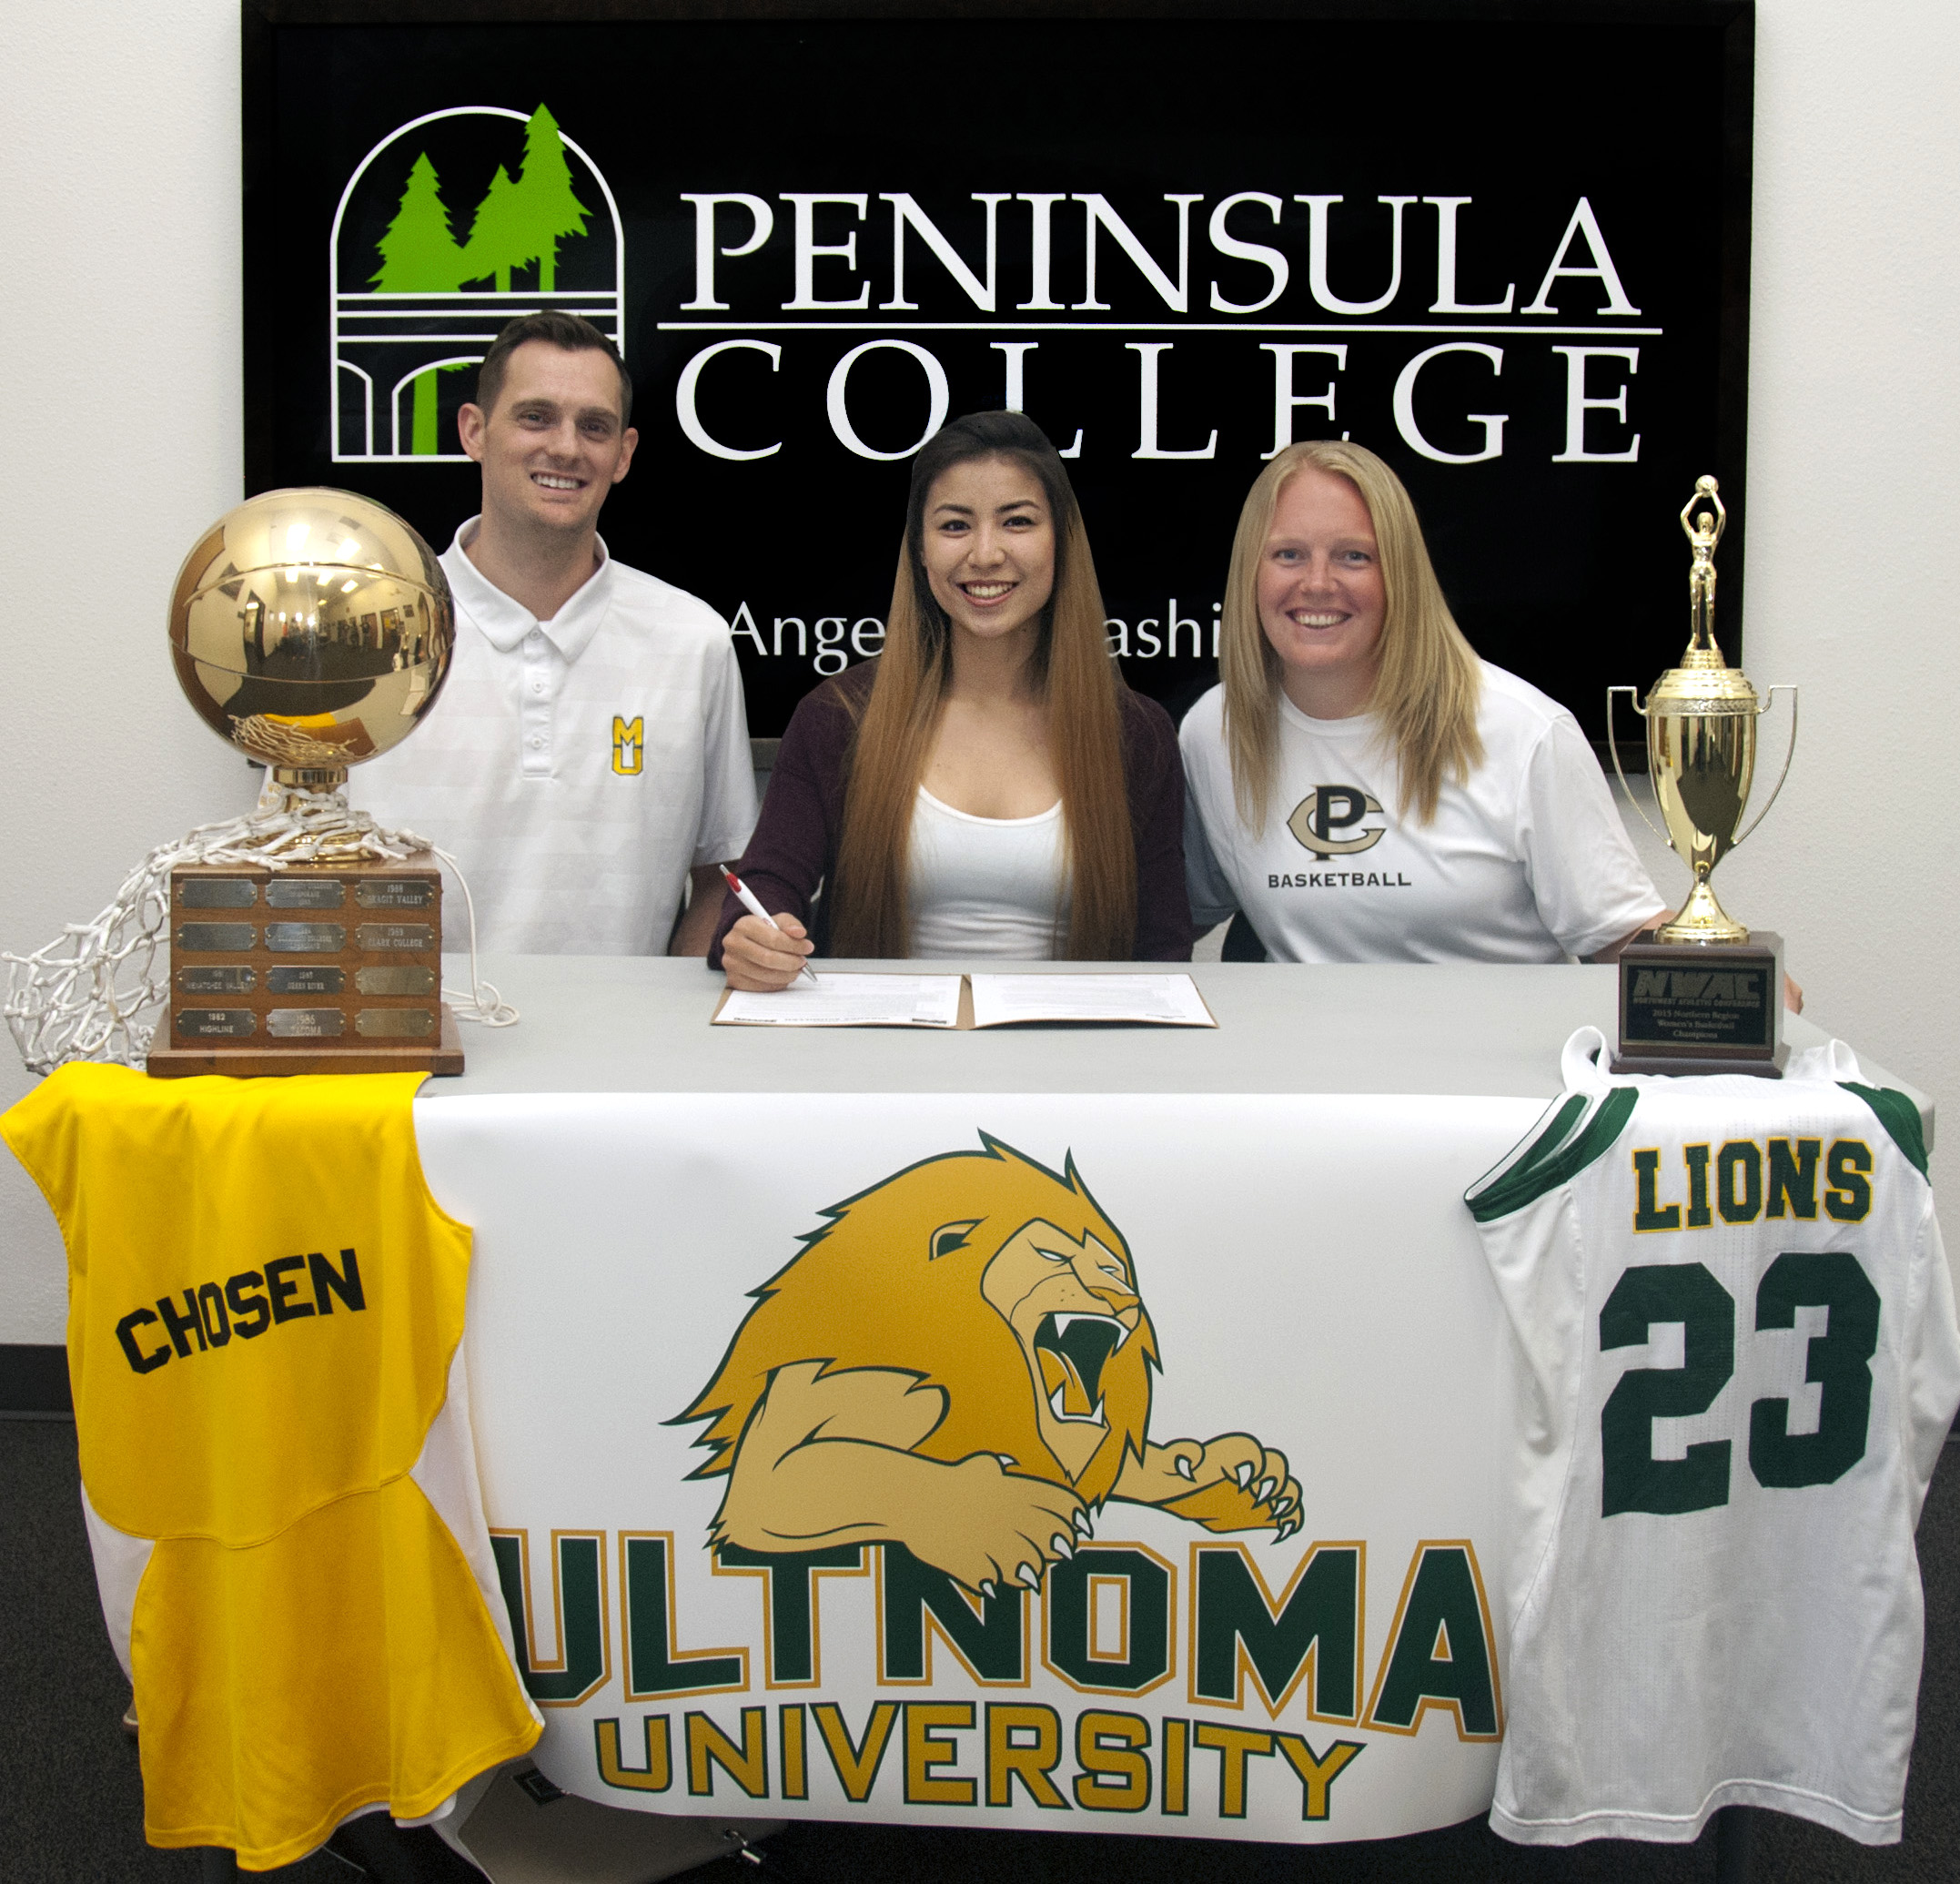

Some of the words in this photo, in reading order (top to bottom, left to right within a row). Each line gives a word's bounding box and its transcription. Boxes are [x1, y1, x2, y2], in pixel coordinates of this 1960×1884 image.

[680, 191, 1642, 316] PENINSULA
[730, 601, 886, 675] Ange
[396, 895, 423, 905] VALLEY
[1268, 872, 1412, 888] BASKETBALL
[393, 937, 423, 947] COLLEGE
[1633, 969, 1761, 1000] NWAC
[199, 1025, 234, 1034] HIGHLINE
[1656, 1018, 1693, 1028] Women's
[1694, 1020, 1735, 1029] Basketball
[1673, 1010, 1711, 1018] Northern
[1712, 1011, 1740, 1020] Region
[1631, 1137, 1874, 1234] LIONS
[115, 1248, 367, 1374] CHOSEN
[1600, 1252, 1882, 1518] 23
[489, 1526, 1505, 1743] ULTNOMA
[593, 1700, 1369, 1821] UNIVERSITY
